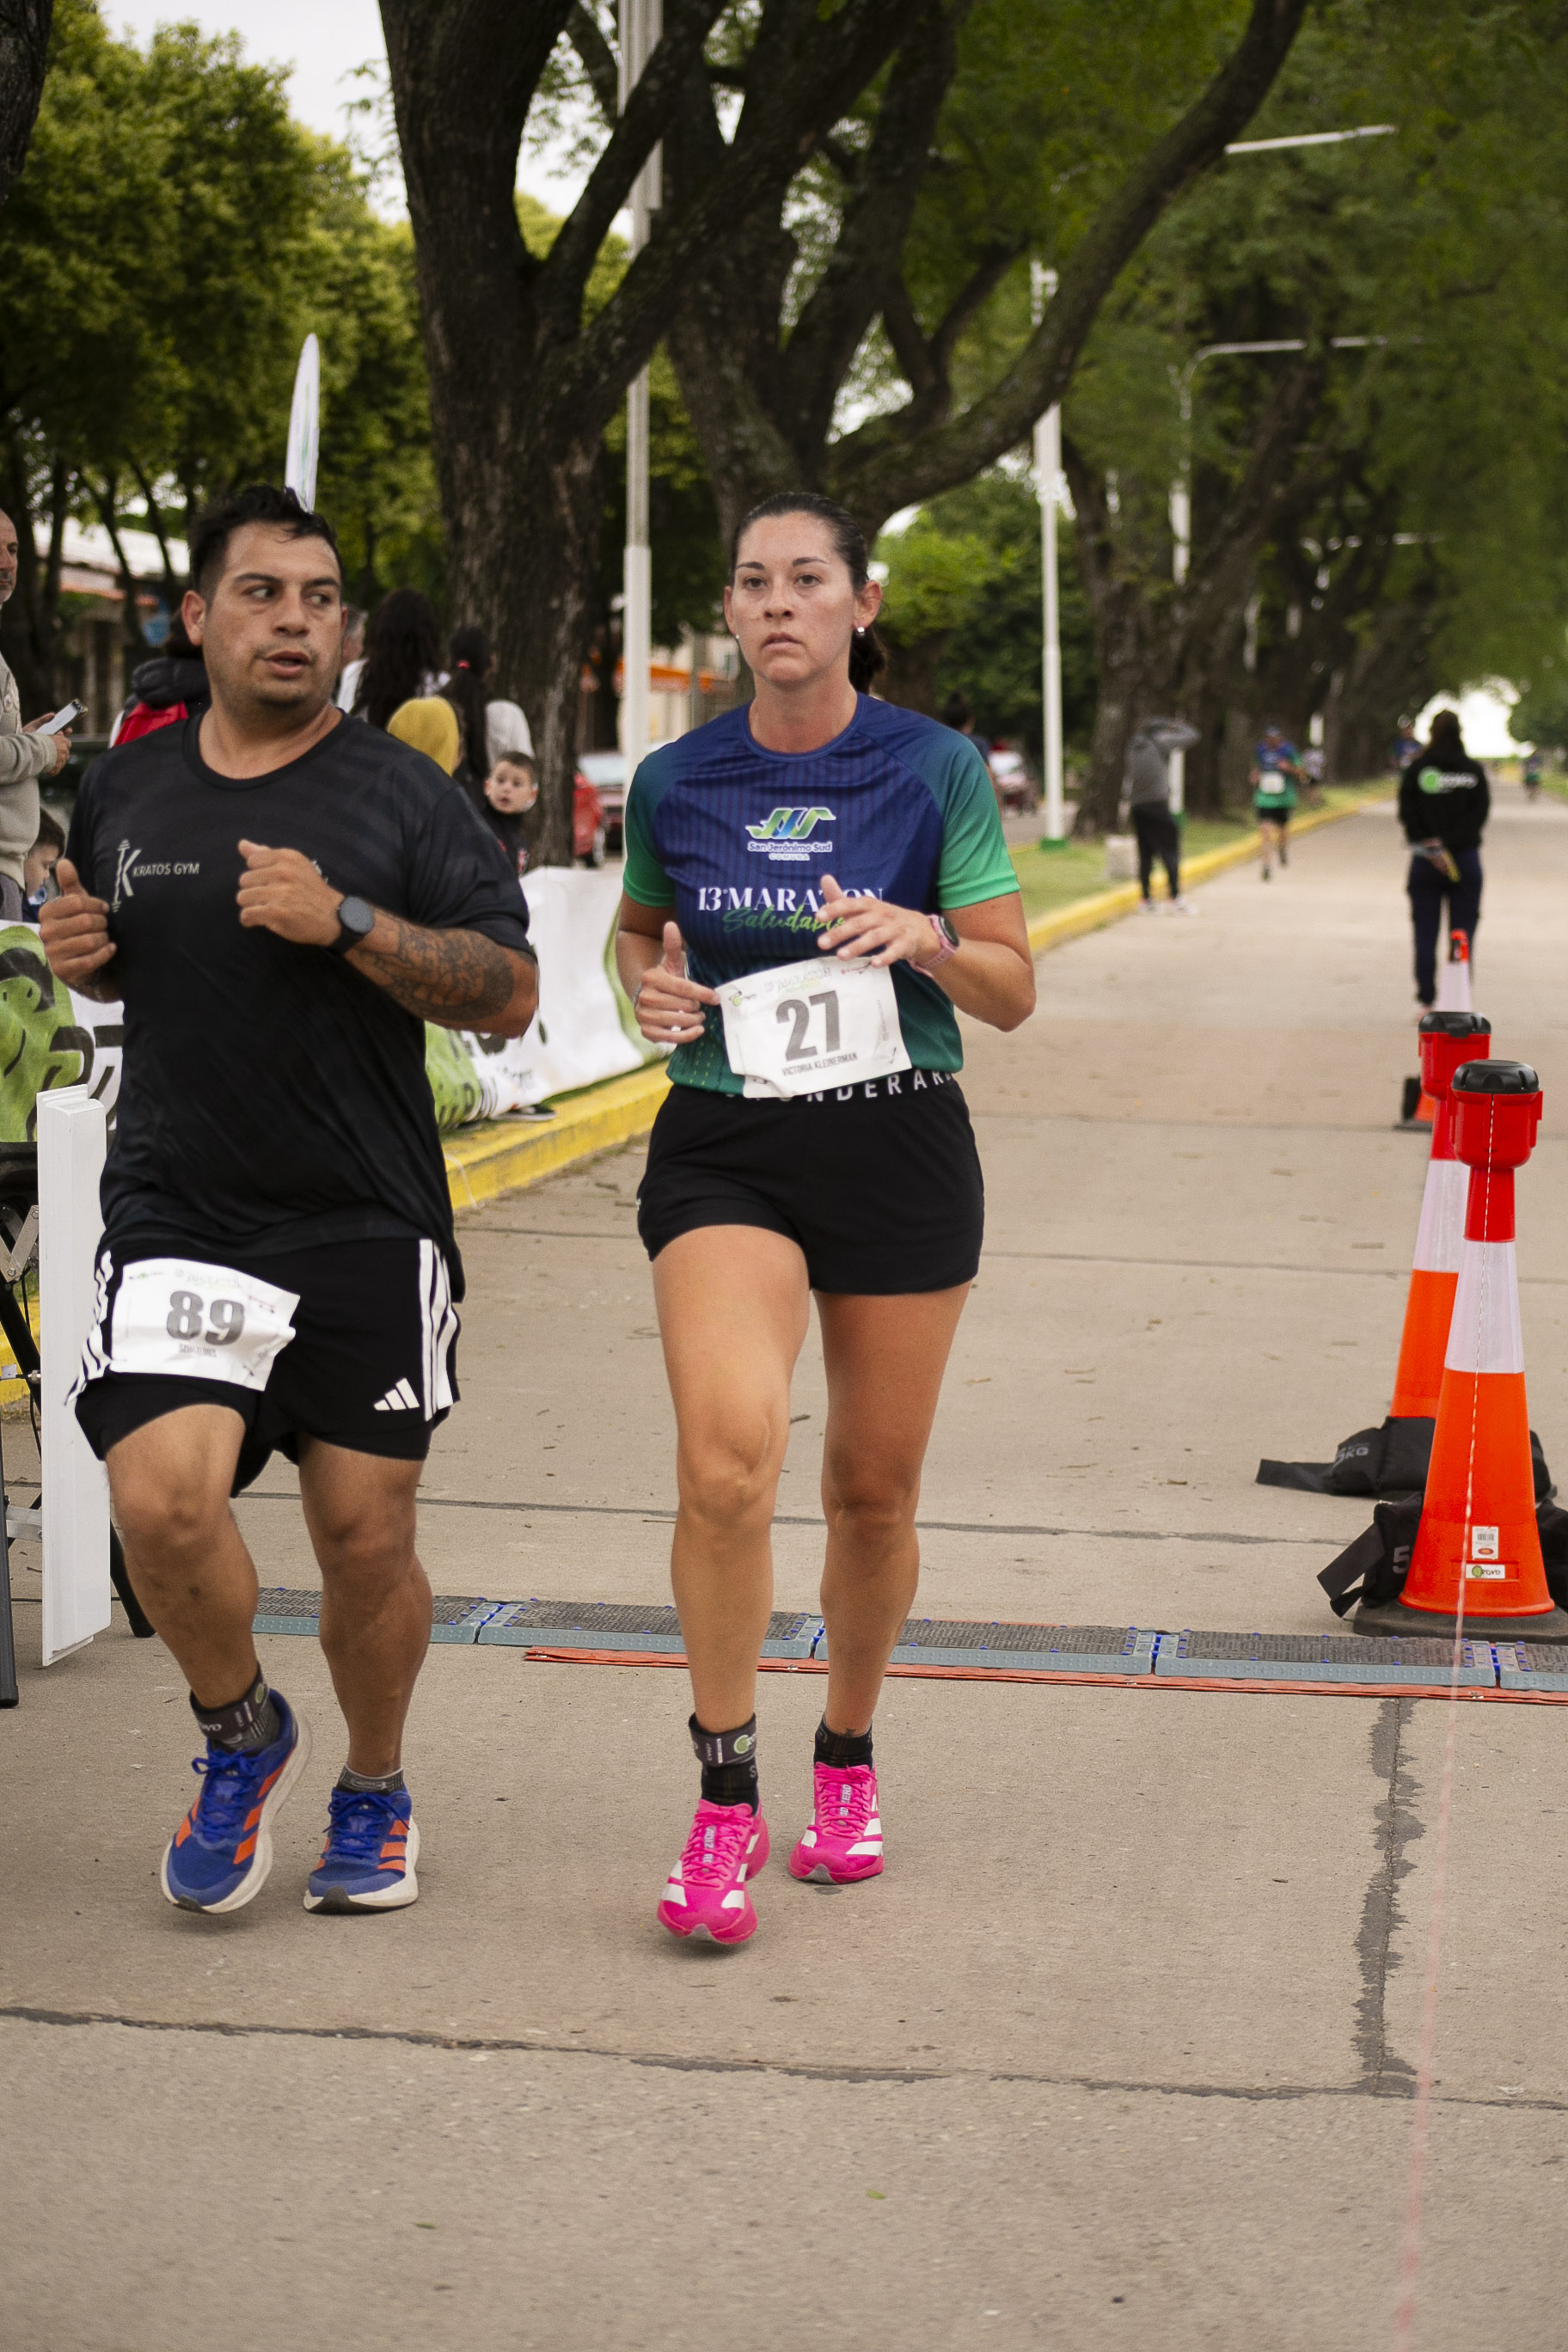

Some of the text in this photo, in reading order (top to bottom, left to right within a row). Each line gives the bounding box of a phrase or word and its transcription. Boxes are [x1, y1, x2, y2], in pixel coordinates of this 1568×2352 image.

[749, 842, 767, 853] San
[813, 841, 832, 853] Sud
[132, 862, 200, 877] KRATOS GYM
[775, 990, 841, 1062] 27
[781, 1051, 858, 1076] VICTORIA KLEINERMAN
[167, 1290, 245, 1345] 89
